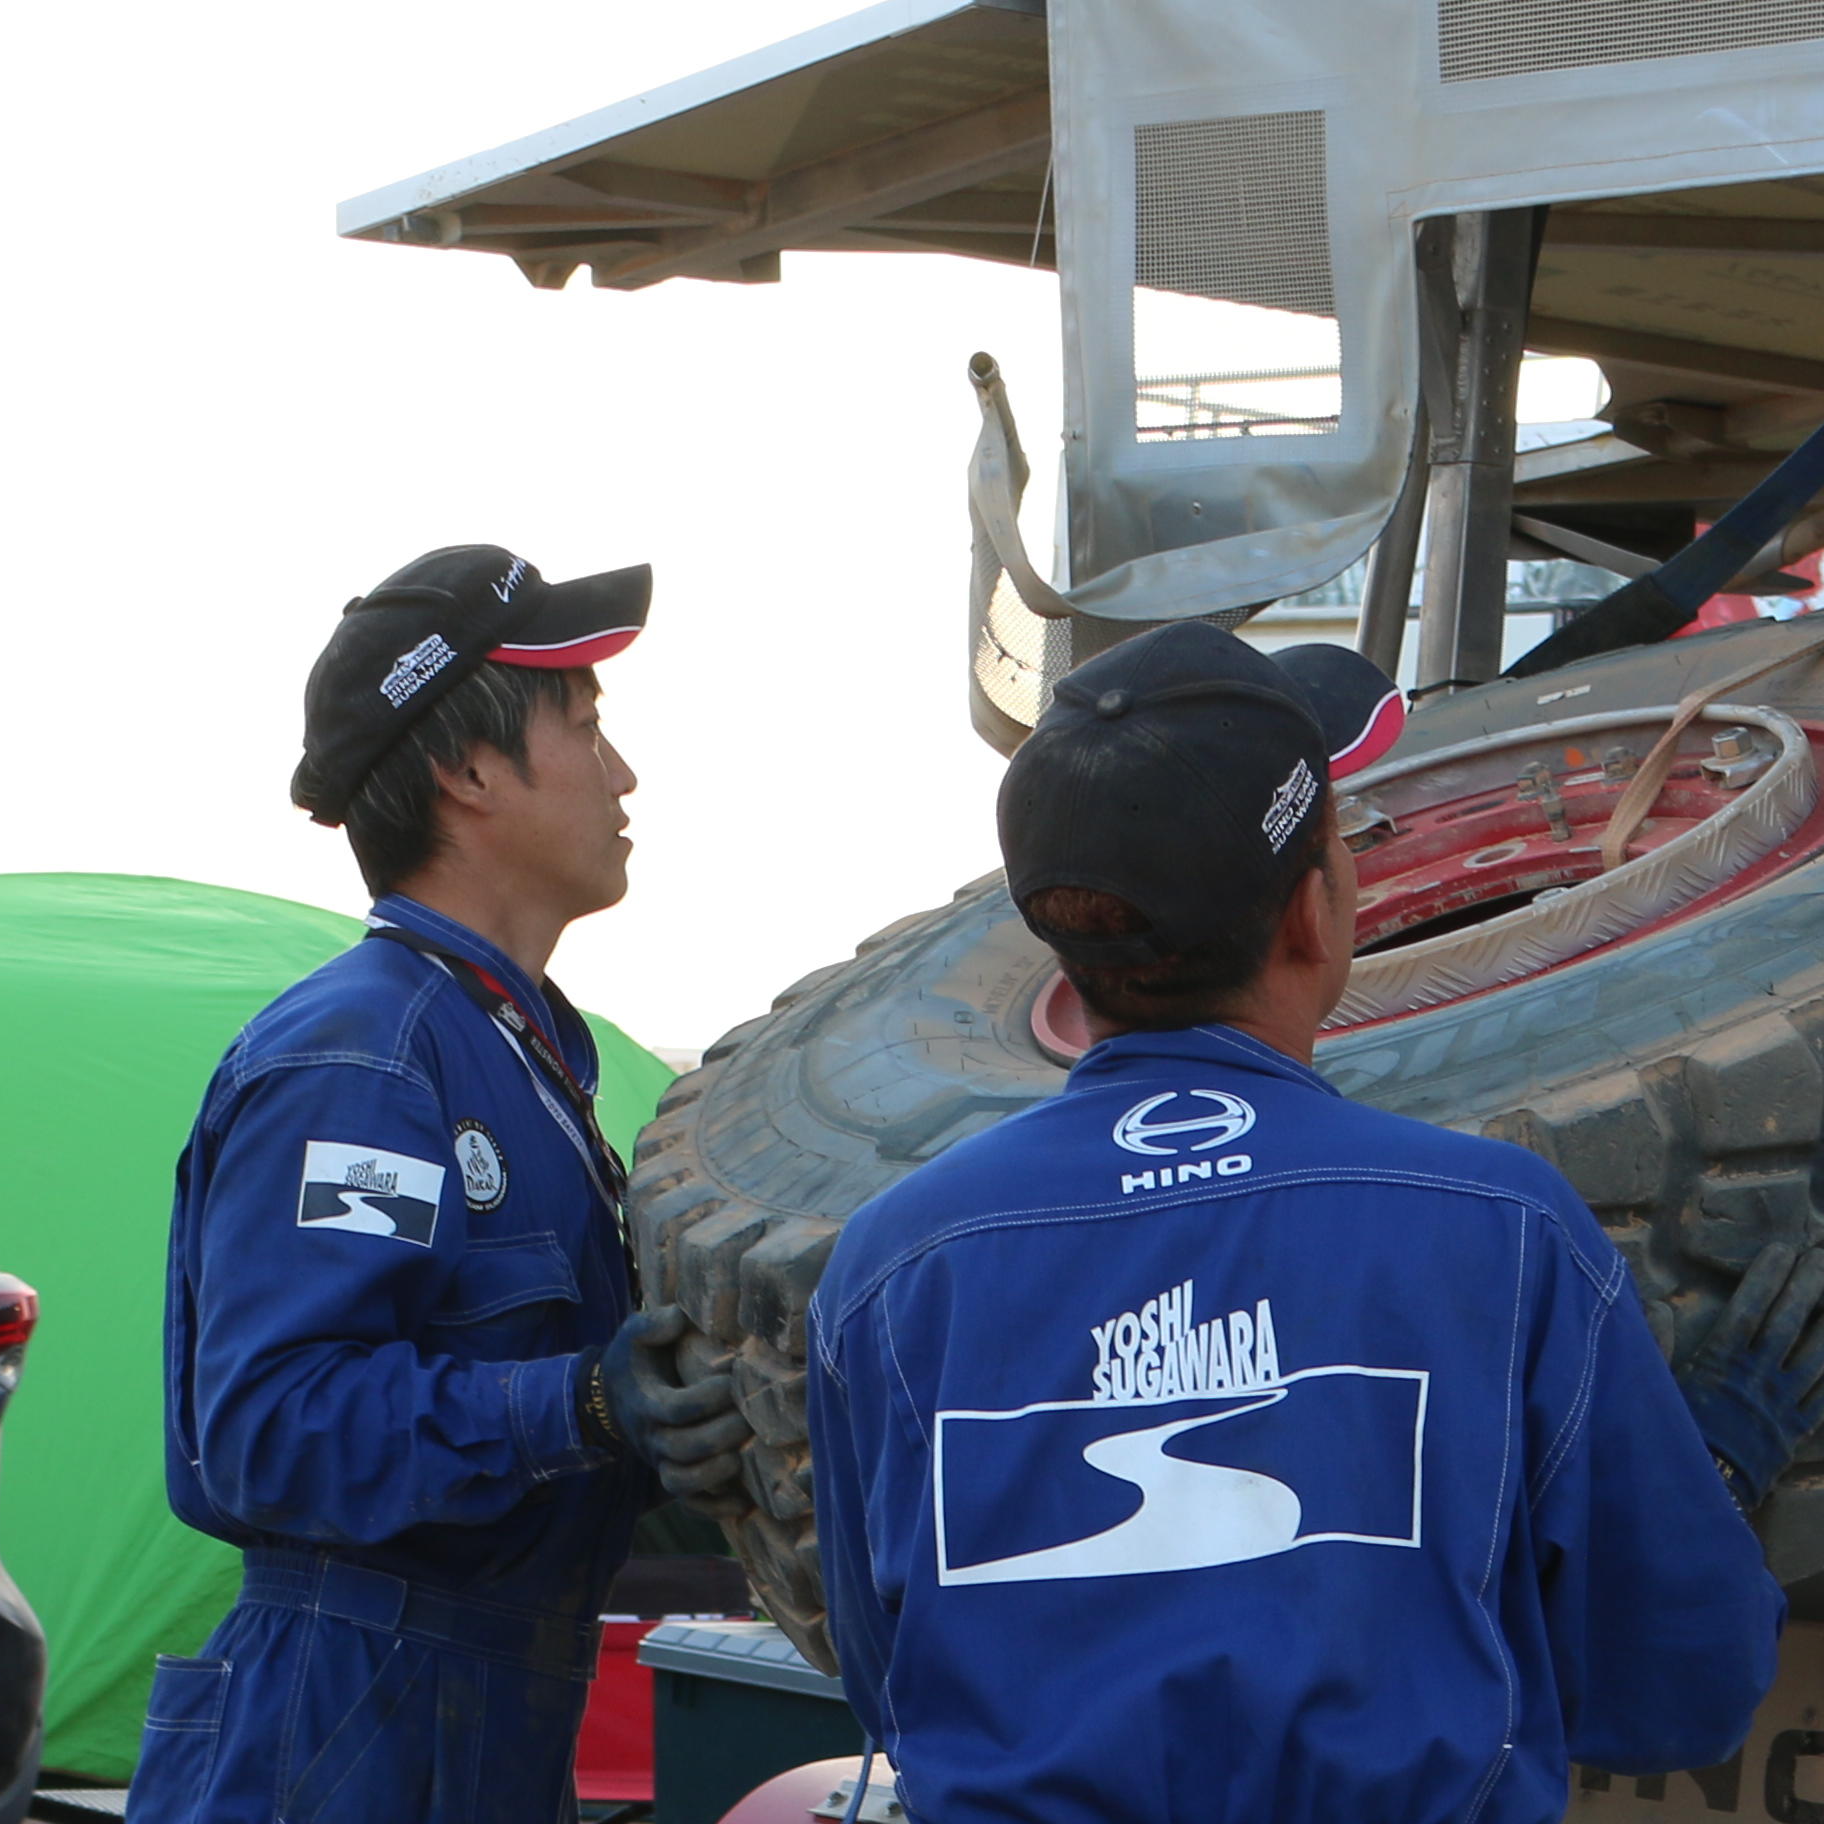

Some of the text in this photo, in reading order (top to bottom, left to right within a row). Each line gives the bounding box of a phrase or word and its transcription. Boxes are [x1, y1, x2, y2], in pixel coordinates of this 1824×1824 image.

[386, 671, 418, 701] HINO
[417, 642, 450, 672] TEAM
[1268, 806, 1294, 844] HINO
[1293, 770, 1313, 806] TEAM
[1122, 1154, 1253, 1195] HINO
[1090, 1279, 1194, 1364] YOSHI
[1092, 1298, 1280, 1401] SUGAWARA
